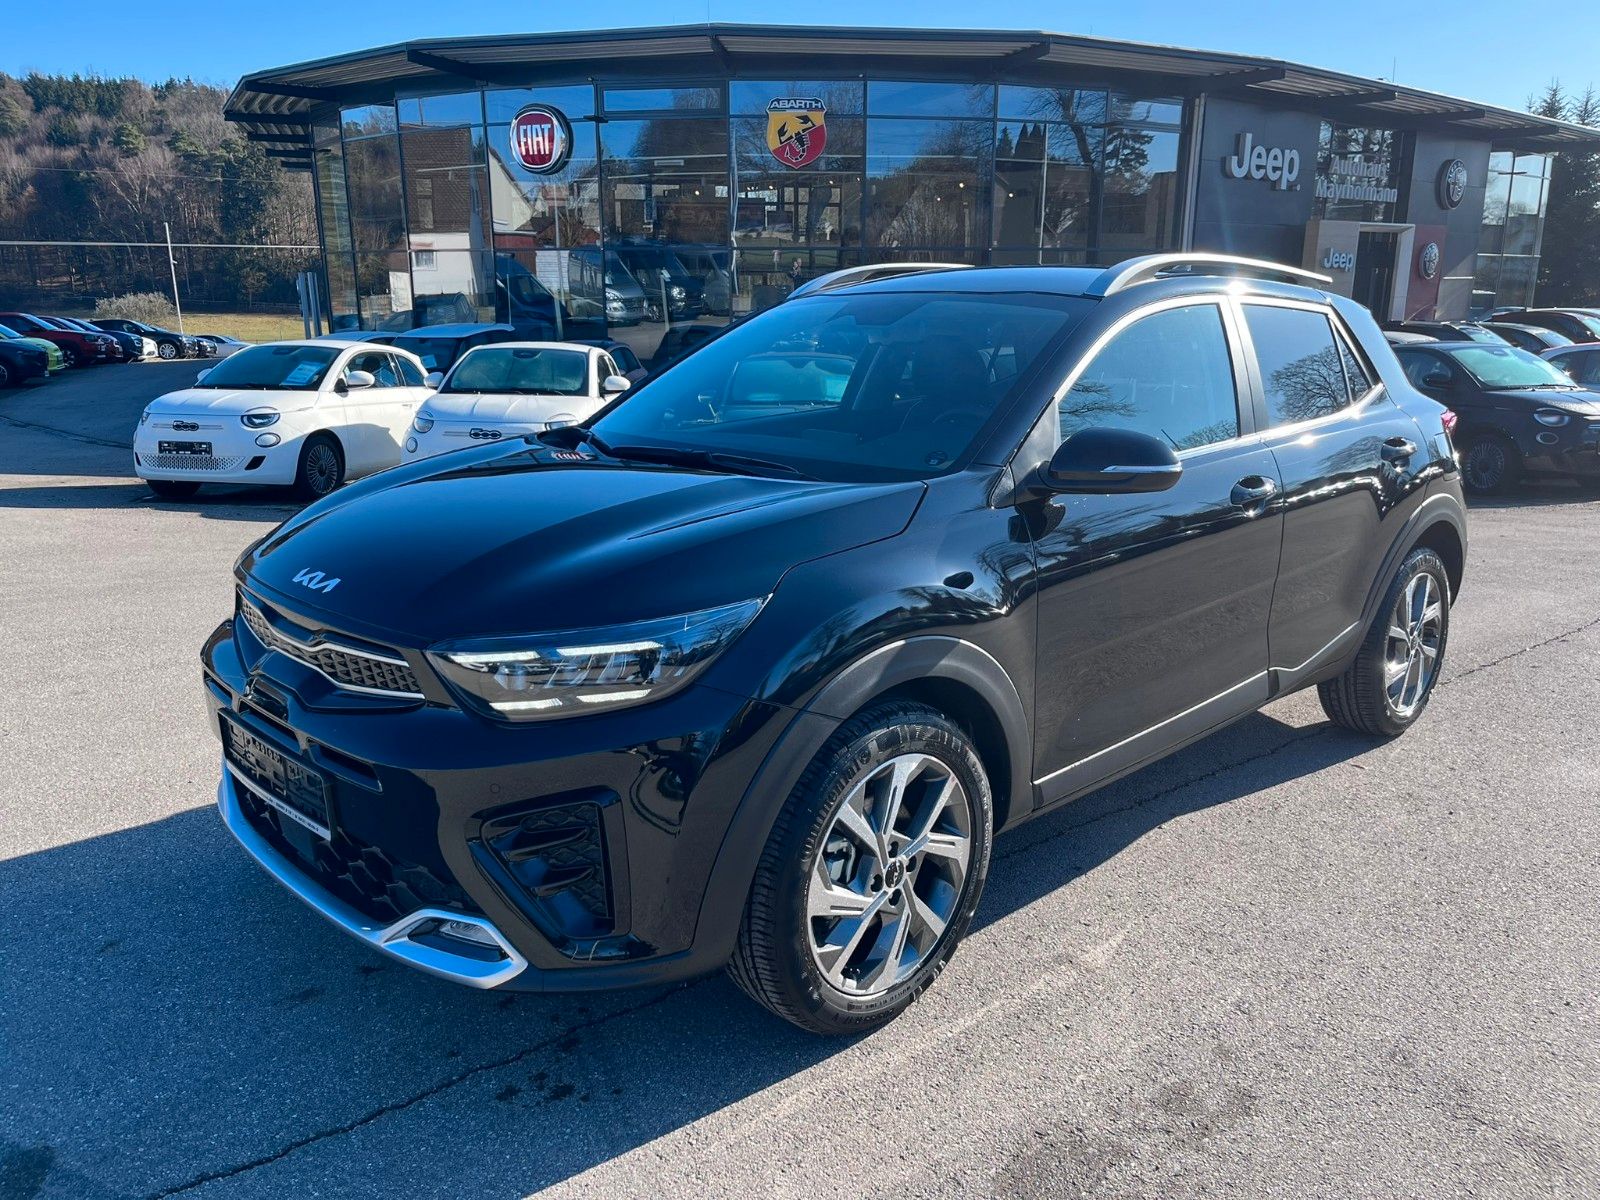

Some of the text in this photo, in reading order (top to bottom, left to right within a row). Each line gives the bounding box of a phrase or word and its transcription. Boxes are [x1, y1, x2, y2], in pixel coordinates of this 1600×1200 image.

[770, 100, 822, 109] ABARTH
[518, 122, 553, 156] FIAT
[1231, 132, 1300, 191] Jeep
[1329, 153, 1389, 179] Autohaus
[1324, 247, 1354, 272] Jeep
[172, 420, 200, 431] 500
[469, 428, 502, 439] 500
